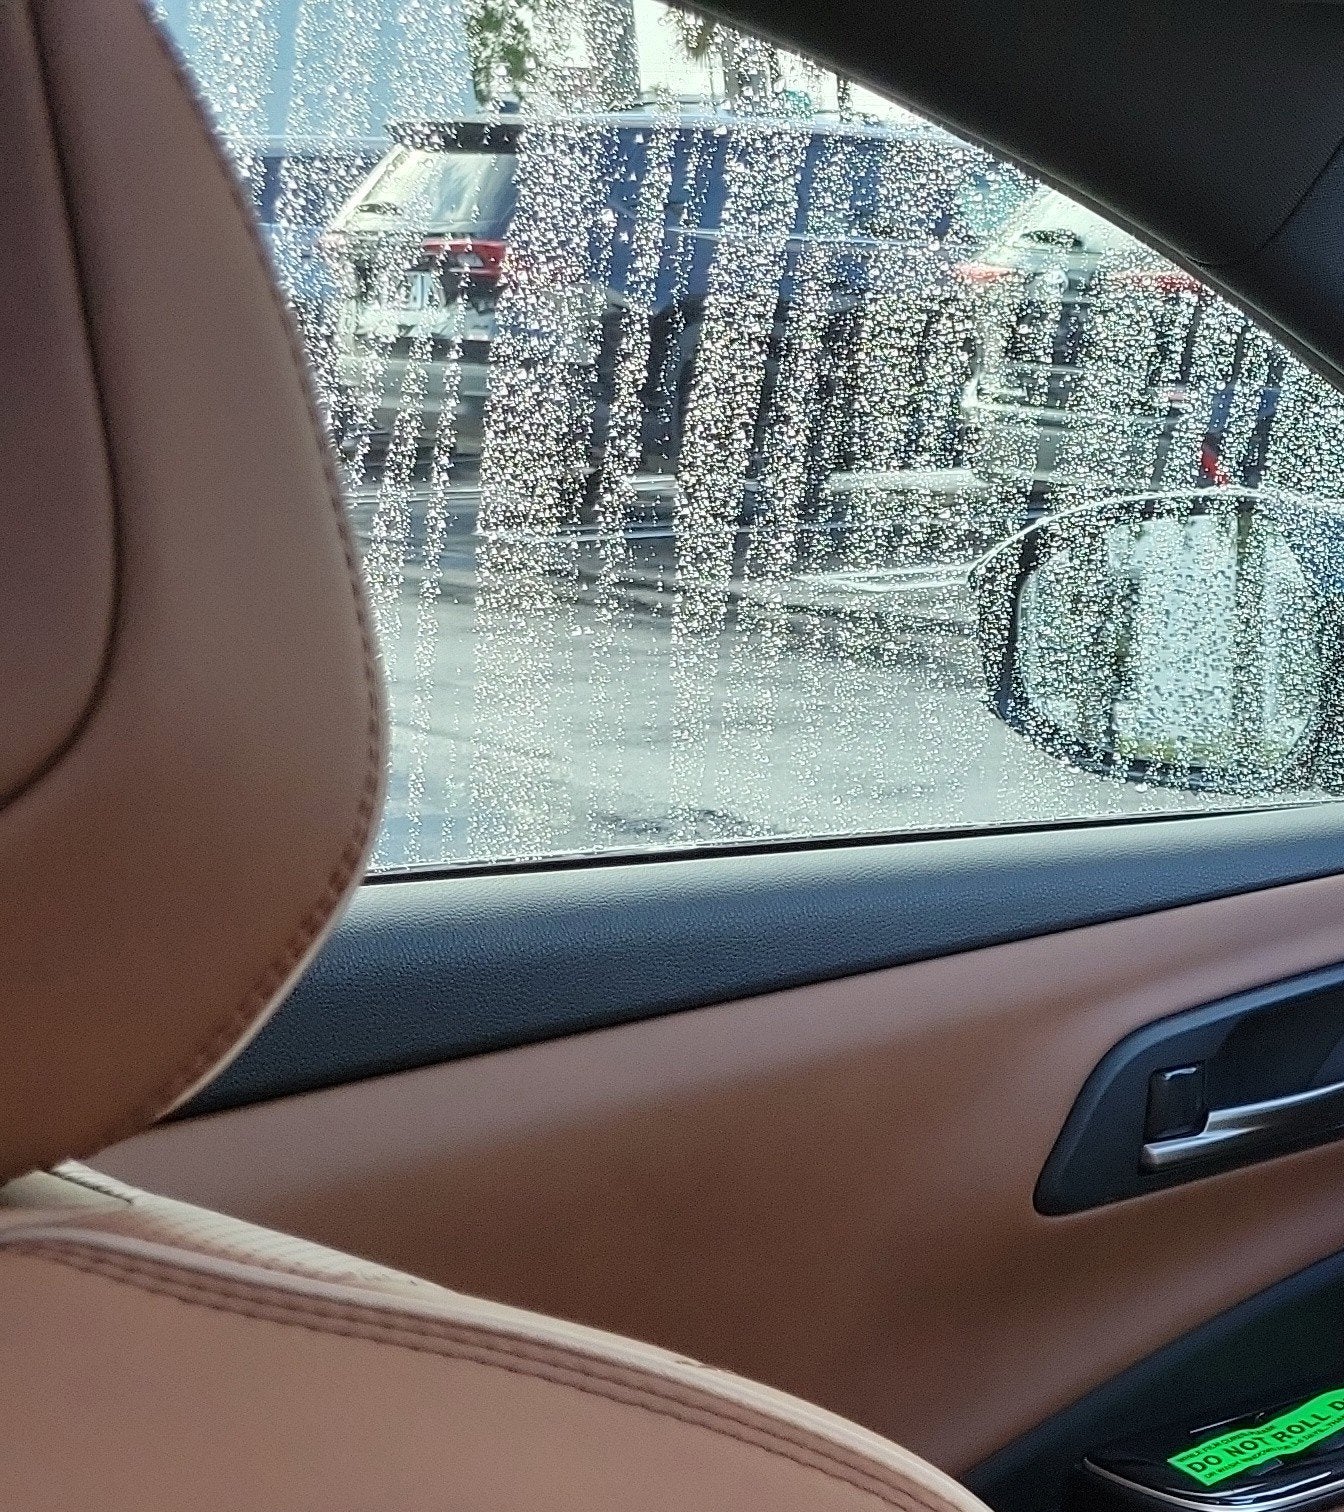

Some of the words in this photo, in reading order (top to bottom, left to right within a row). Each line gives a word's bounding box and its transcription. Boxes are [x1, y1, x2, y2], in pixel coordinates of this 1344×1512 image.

[1187, 1454, 1223, 1473] DO
[1223, 1436, 1272, 1457] NOT
[1271, 1413, 1332, 1443] ROLL
